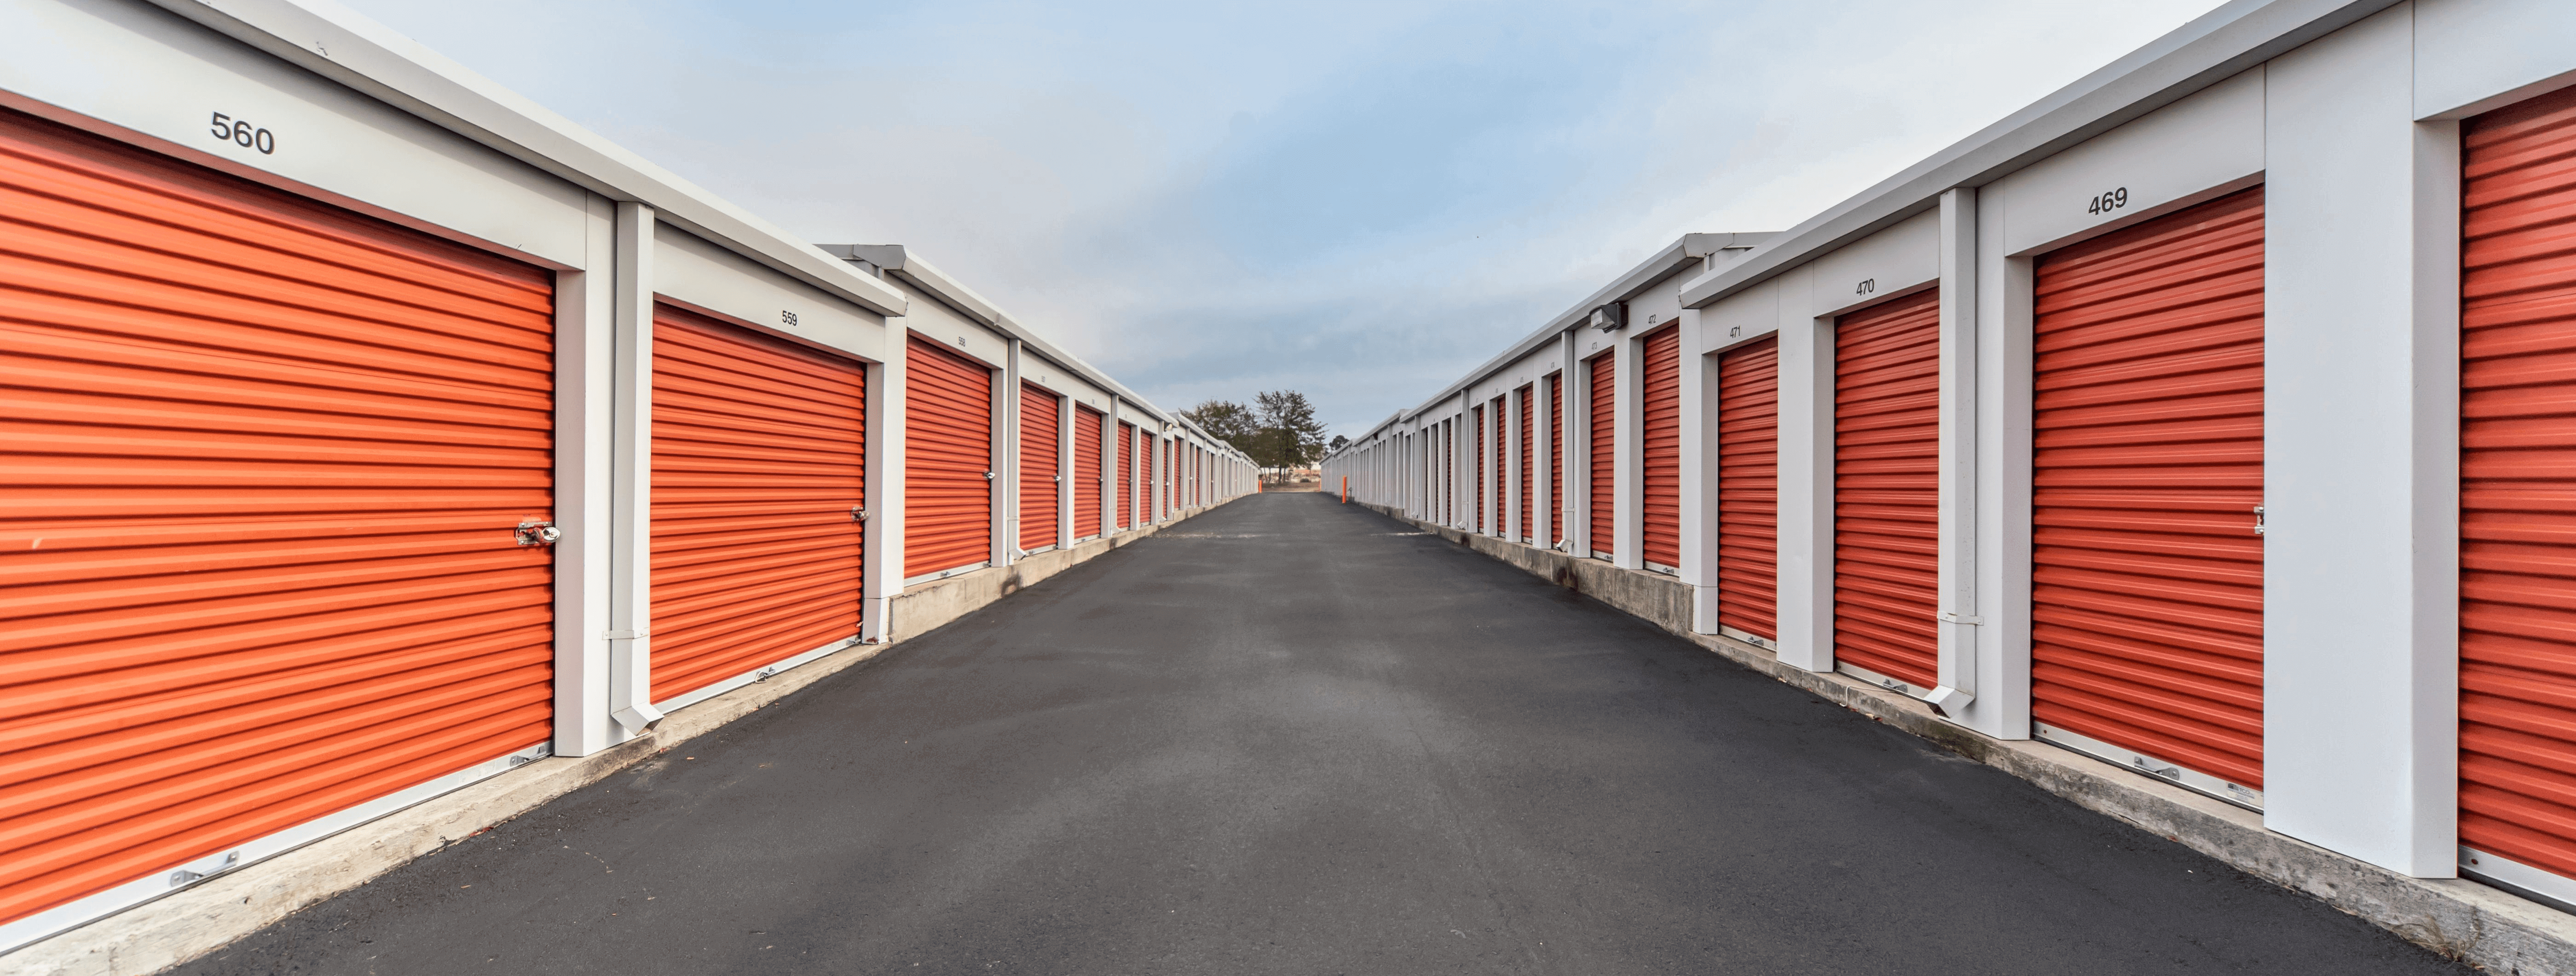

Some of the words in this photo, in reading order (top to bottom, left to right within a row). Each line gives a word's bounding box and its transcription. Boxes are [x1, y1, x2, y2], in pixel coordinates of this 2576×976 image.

[212, 111, 275, 155] 560
[2088, 187, 2128, 216] 469
[1856, 278, 1874, 296] 470
[782, 310, 797, 326] 559
[1730, 325, 1740, 338] 471
